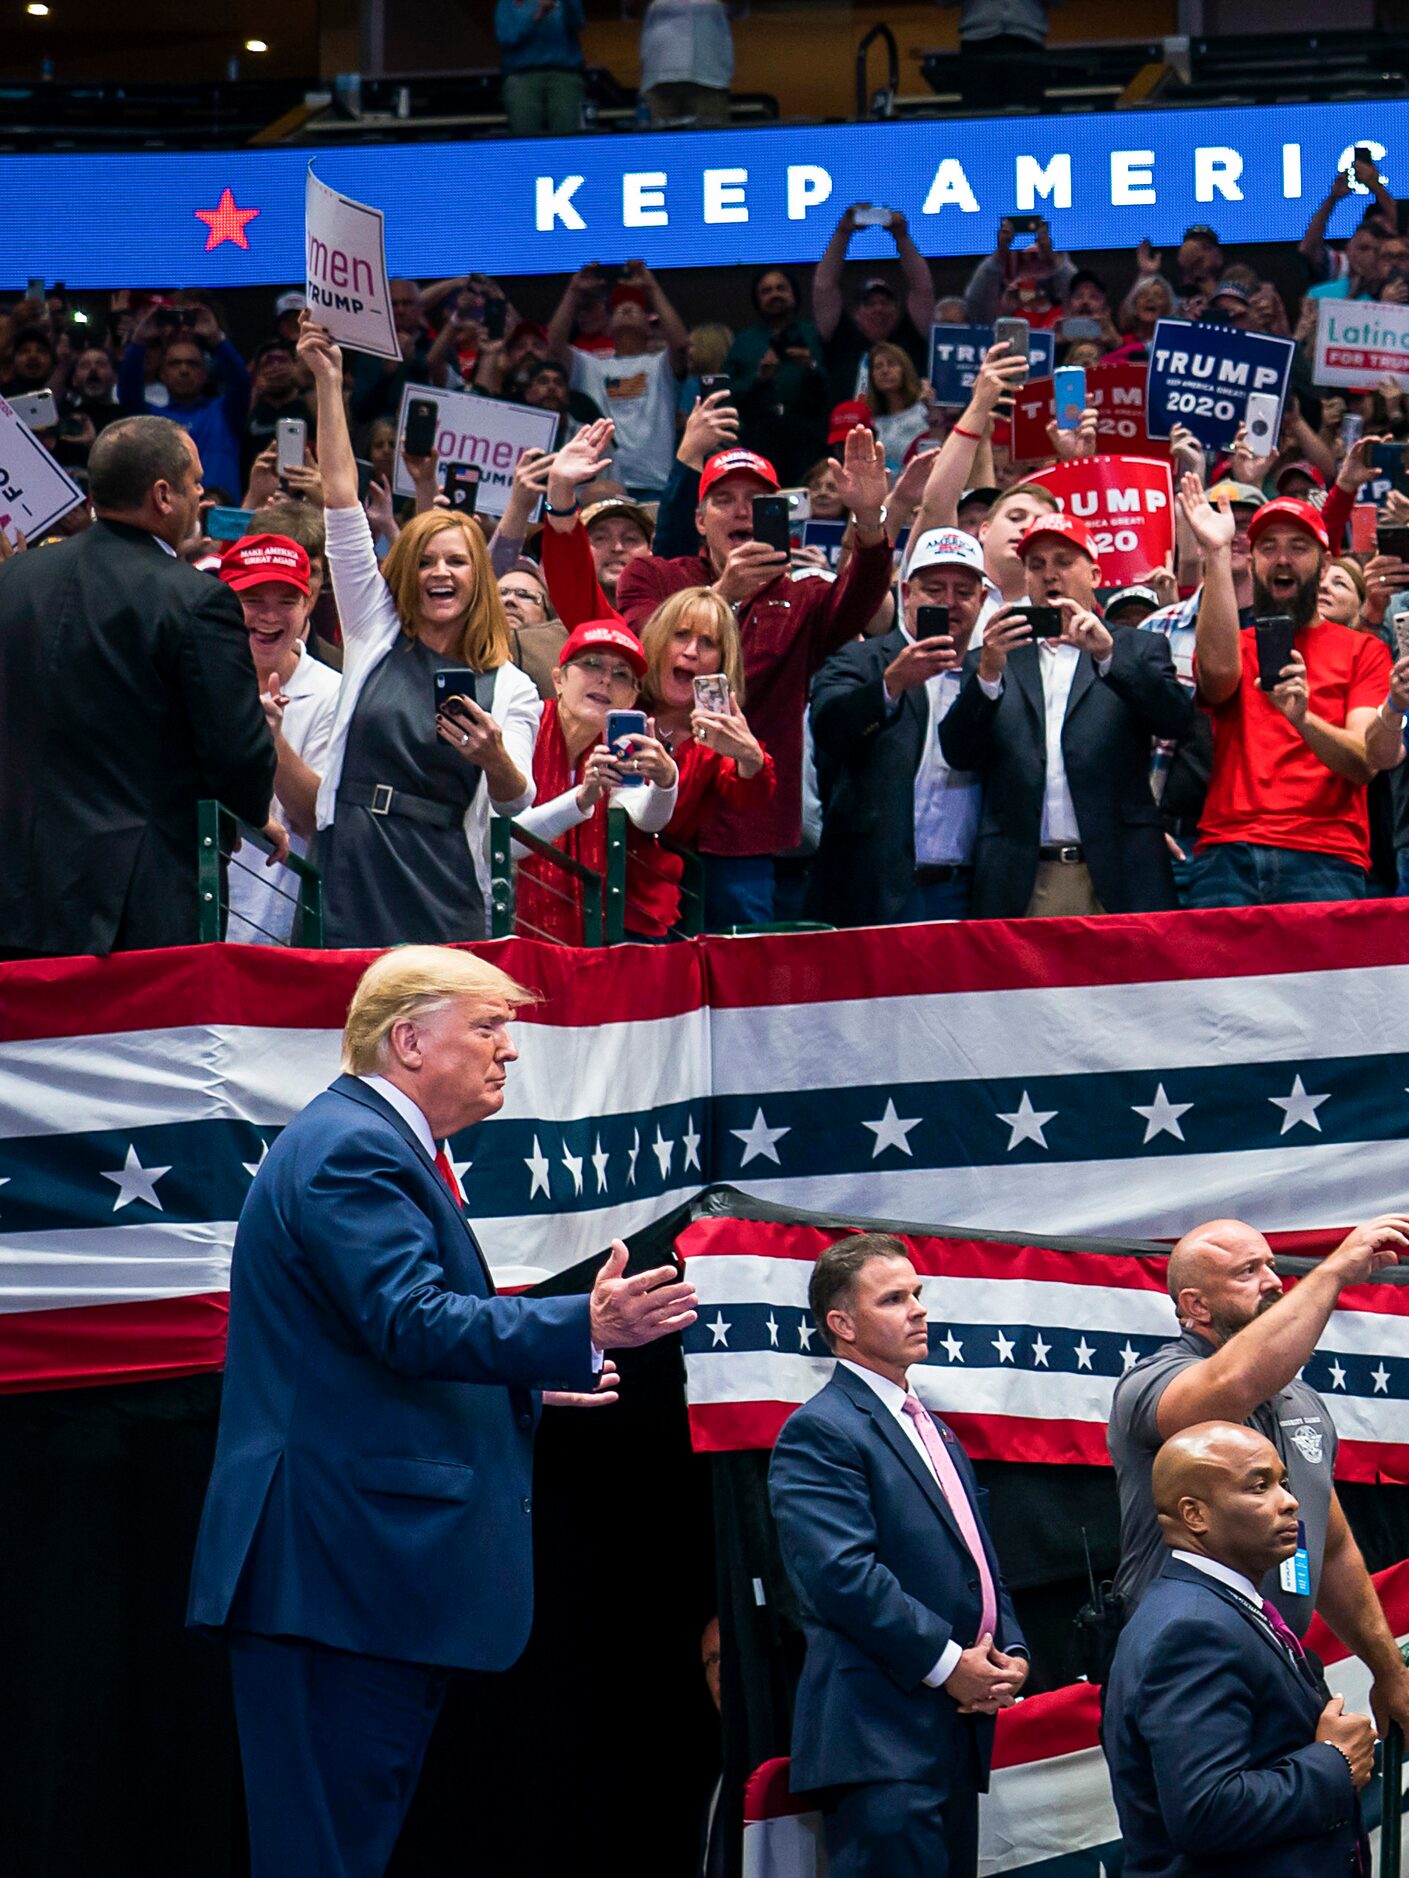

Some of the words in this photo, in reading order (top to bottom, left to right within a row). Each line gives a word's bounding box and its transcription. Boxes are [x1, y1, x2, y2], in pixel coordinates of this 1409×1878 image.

[535, 164, 833, 232] KEEP
[308, 231, 375, 297] men
[937, 343, 1048, 364] TRP
[1329, 351, 1365, 364] FOR
[1156, 349, 1280, 390] TRUMP
[1182, 380, 1215, 393] AMERICA
[1166, 391, 1236, 422] 2020
[434, 416, 537, 470] ome
[1099, 420, 1138, 438] 20
[1056, 487, 1167, 518] UMP
[1095, 530, 1139, 553] 20
